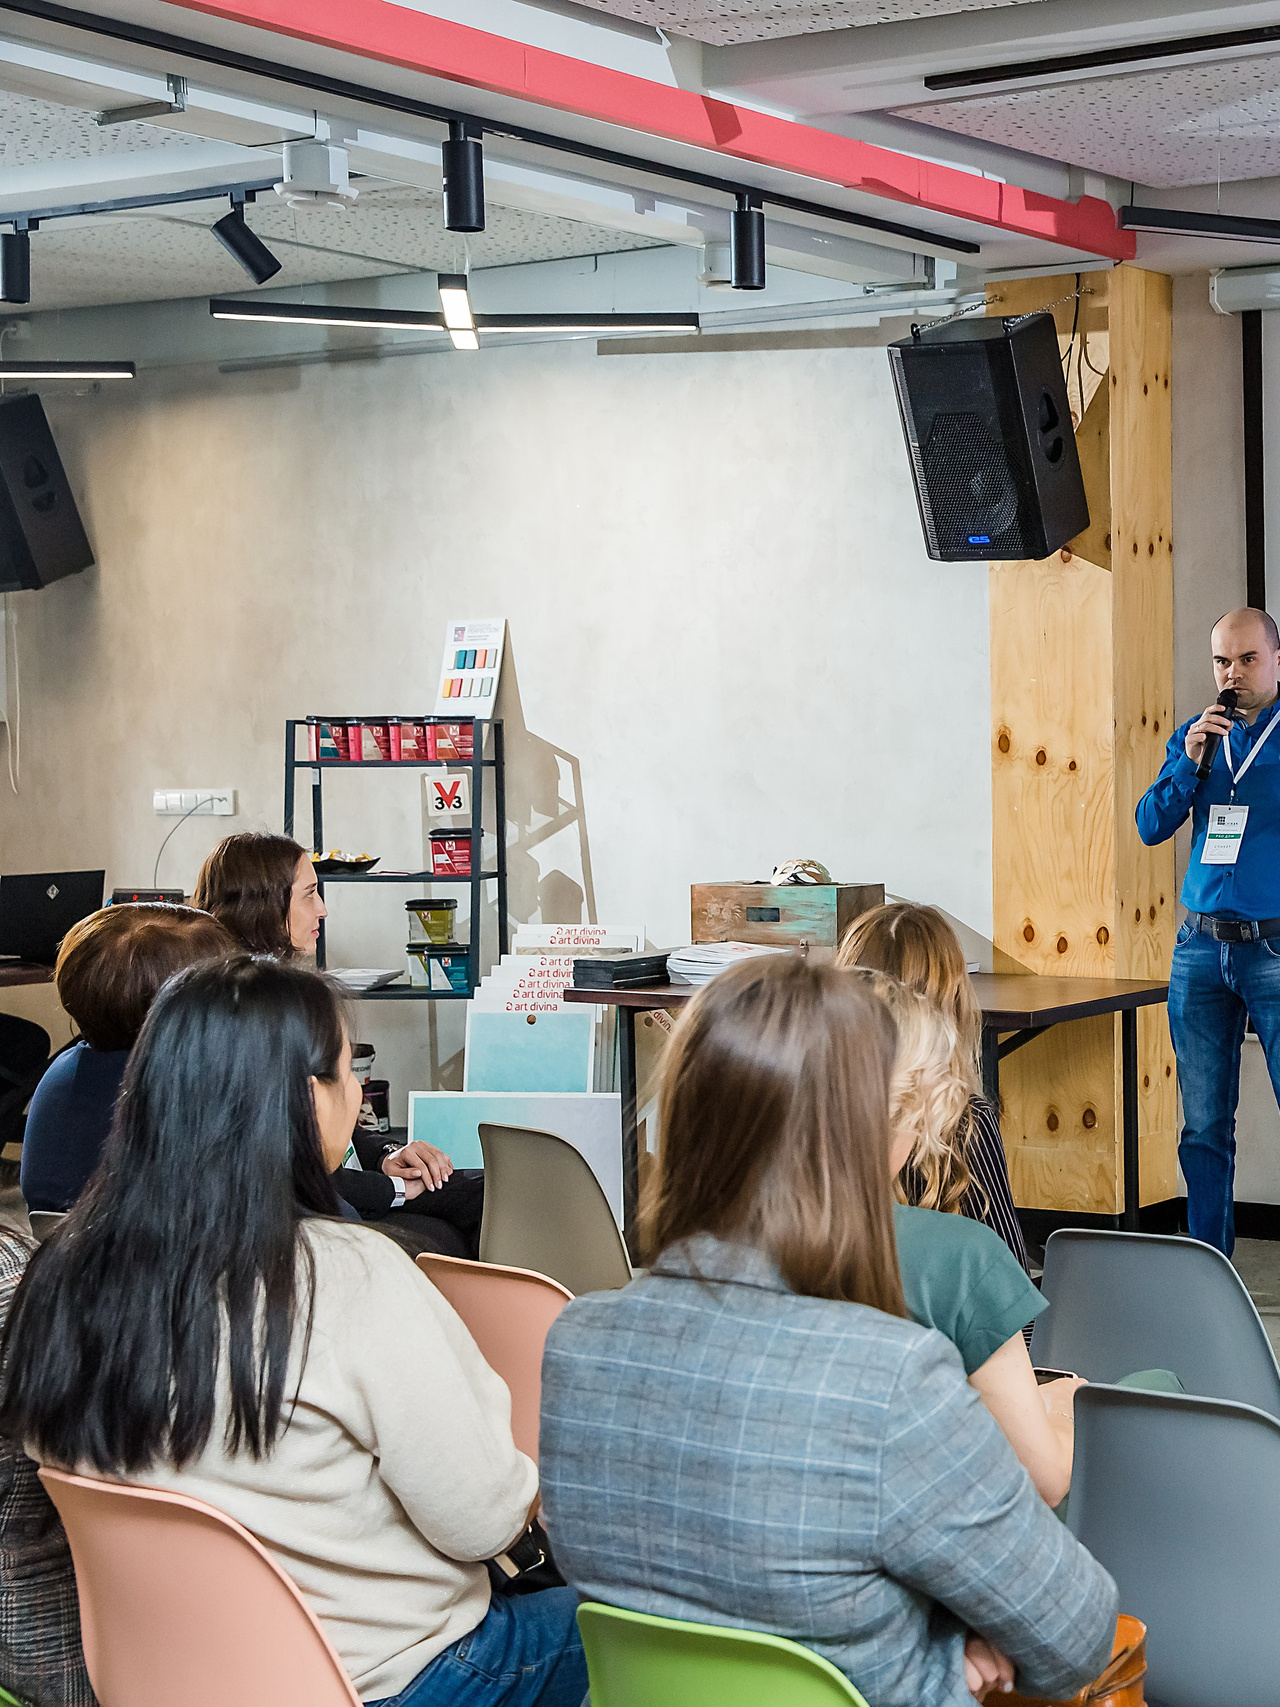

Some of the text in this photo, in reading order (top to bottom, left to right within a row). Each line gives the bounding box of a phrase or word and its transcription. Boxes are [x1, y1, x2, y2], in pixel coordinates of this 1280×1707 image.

[564, 927, 607, 936] art divina
[558, 936, 601, 945] art divina
[548, 958, 562, 966] art
[537, 970, 551, 978] art
[527, 980, 571, 989] art divina
[521, 991, 535, 999] art
[514, 1002, 558, 1011] art divina
[653, 1011, 672, 1032] divin
